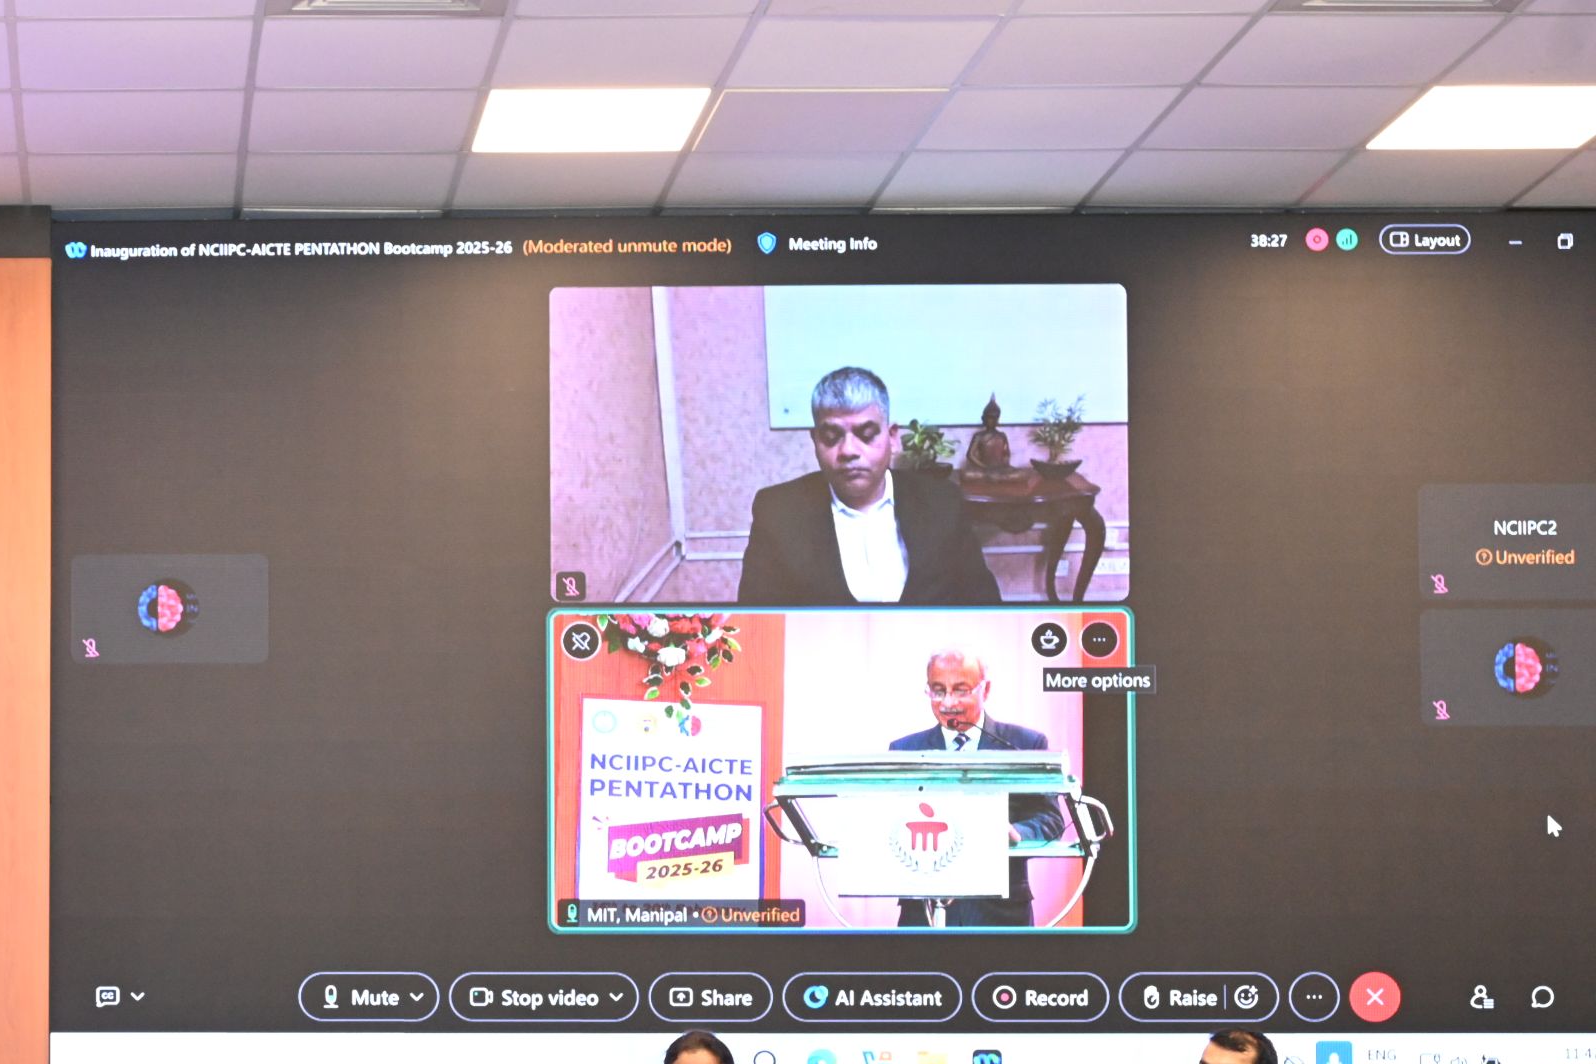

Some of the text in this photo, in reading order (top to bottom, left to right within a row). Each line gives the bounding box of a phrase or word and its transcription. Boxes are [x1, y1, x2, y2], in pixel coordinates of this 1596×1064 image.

[91, 238, 733, 260] Inauguration of NCIIPC-AICTE PENTATHON Bootcamp 2025-26 (Moderated unmute mode)
[789, 236, 878, 254] Meeting Info
[1250, 234, 1288, 248] 38:27
[1414, 234, 1461, 249] Layout
[1494, 520, 1557, 535] NCIIPC2
[1496, 549, 1575, 565] Unverified
[1046, 672, 1151, 691] More options
[590, 753, 753, 775] NCIIPC-AICTE
[590, 779, 752, 801] PENTATHON
[609, 822, 742, 861] BOOTCAMP
[646, 859, 724, 879] 2025-26
[587, 908, 621, 924] MIT,
[625, 907, 688, 925] Manipal
[721, 907, 800, 922] Unverified
[351, 989, 400, 1006] Mute
[501, 988, 599, 1011] Stop video
[701, 988, 753, 1006] Share
[835, 989, 943, 1007] AI Assistant
[1025, 989, 1089, 1006] Record
[1169, 989, 1218, 1006] Raise
[1368, 1050, 1397, 1060] ENG
